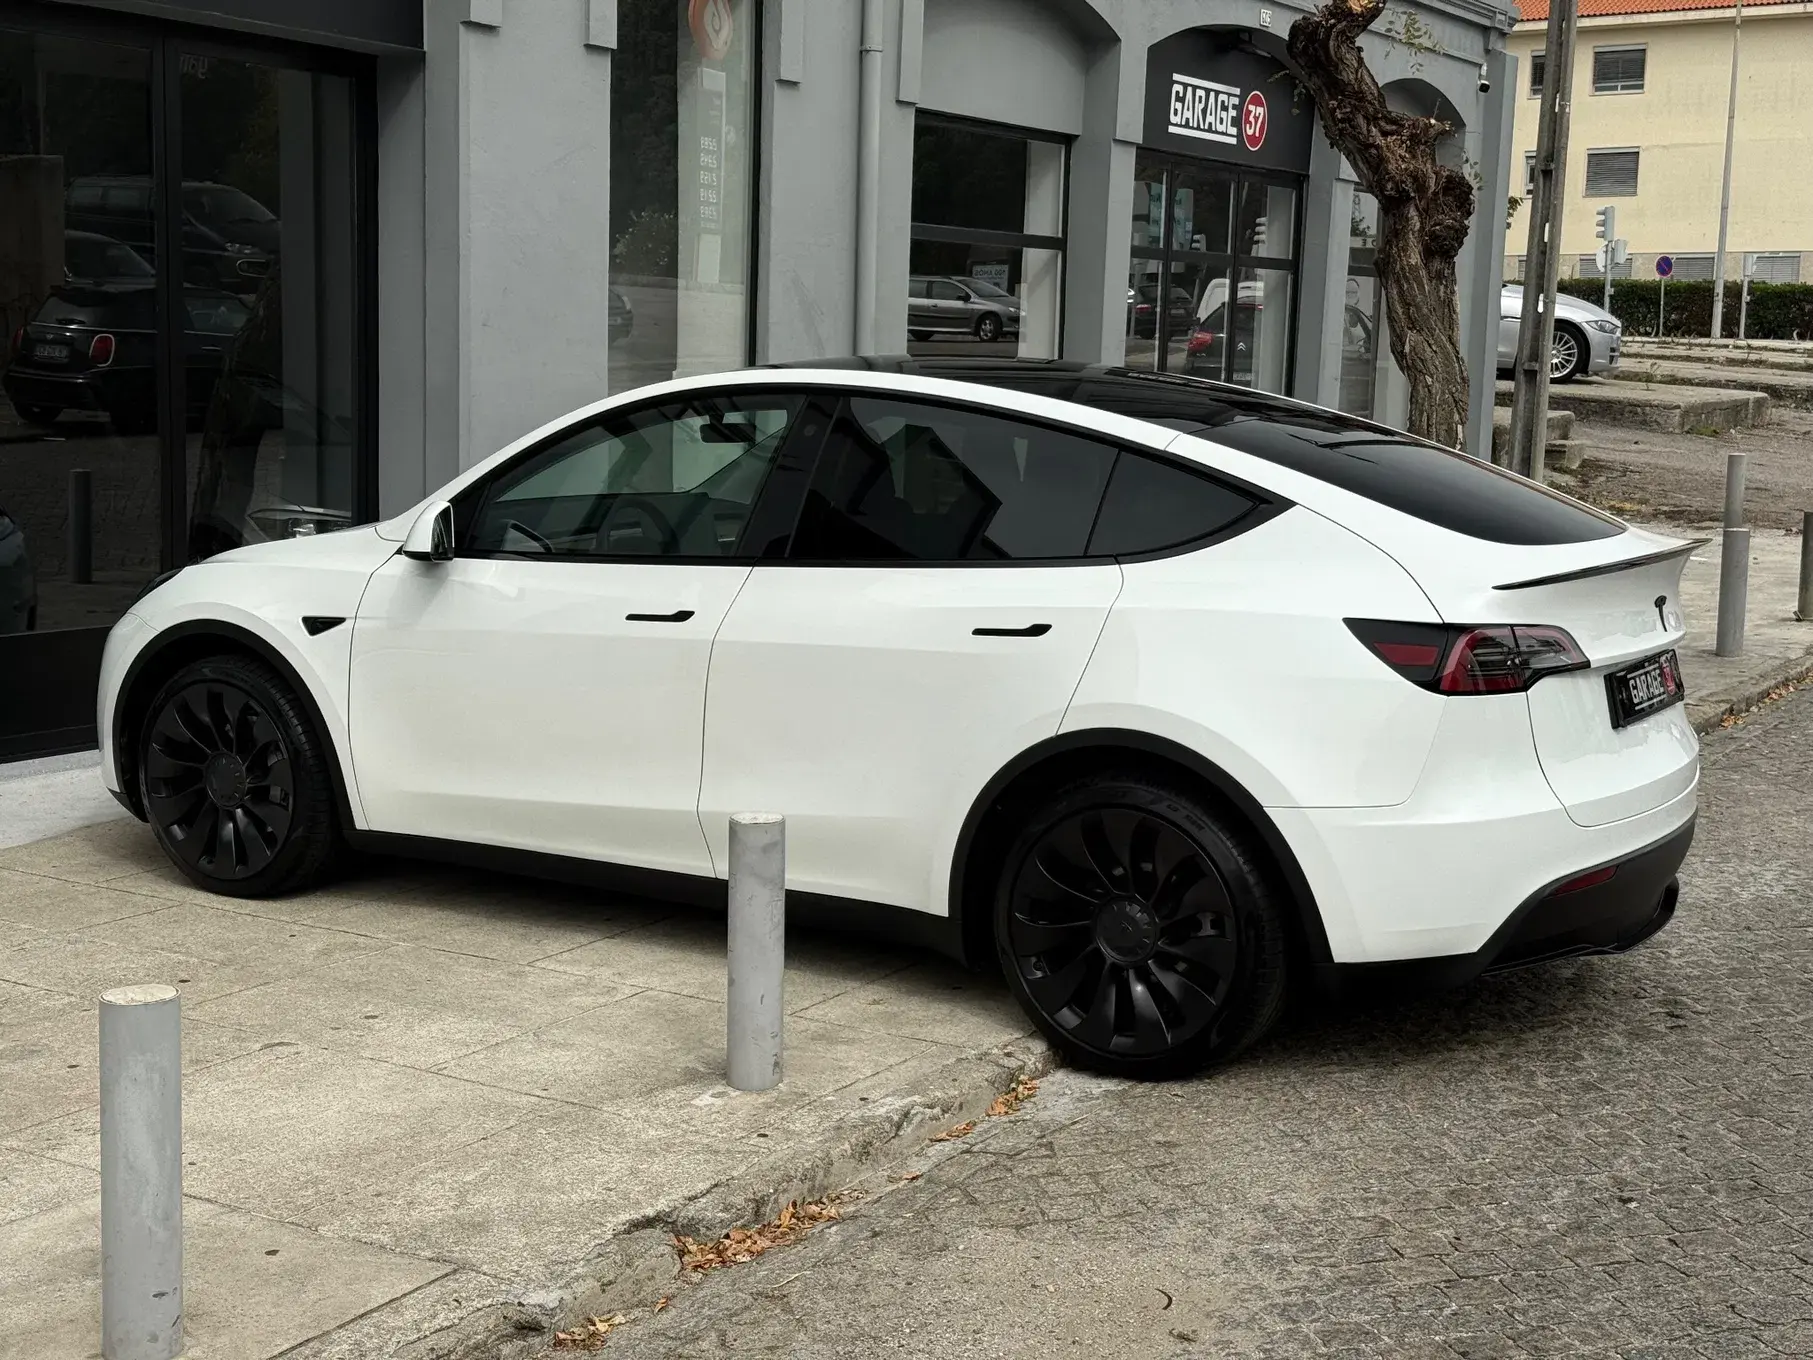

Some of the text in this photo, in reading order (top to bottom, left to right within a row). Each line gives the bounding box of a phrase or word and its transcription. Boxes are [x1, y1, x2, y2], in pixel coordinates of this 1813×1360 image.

[1169, 83, 1264, 138] GARAGE 37
[1629, 669, 1664, 704] GARAGE
